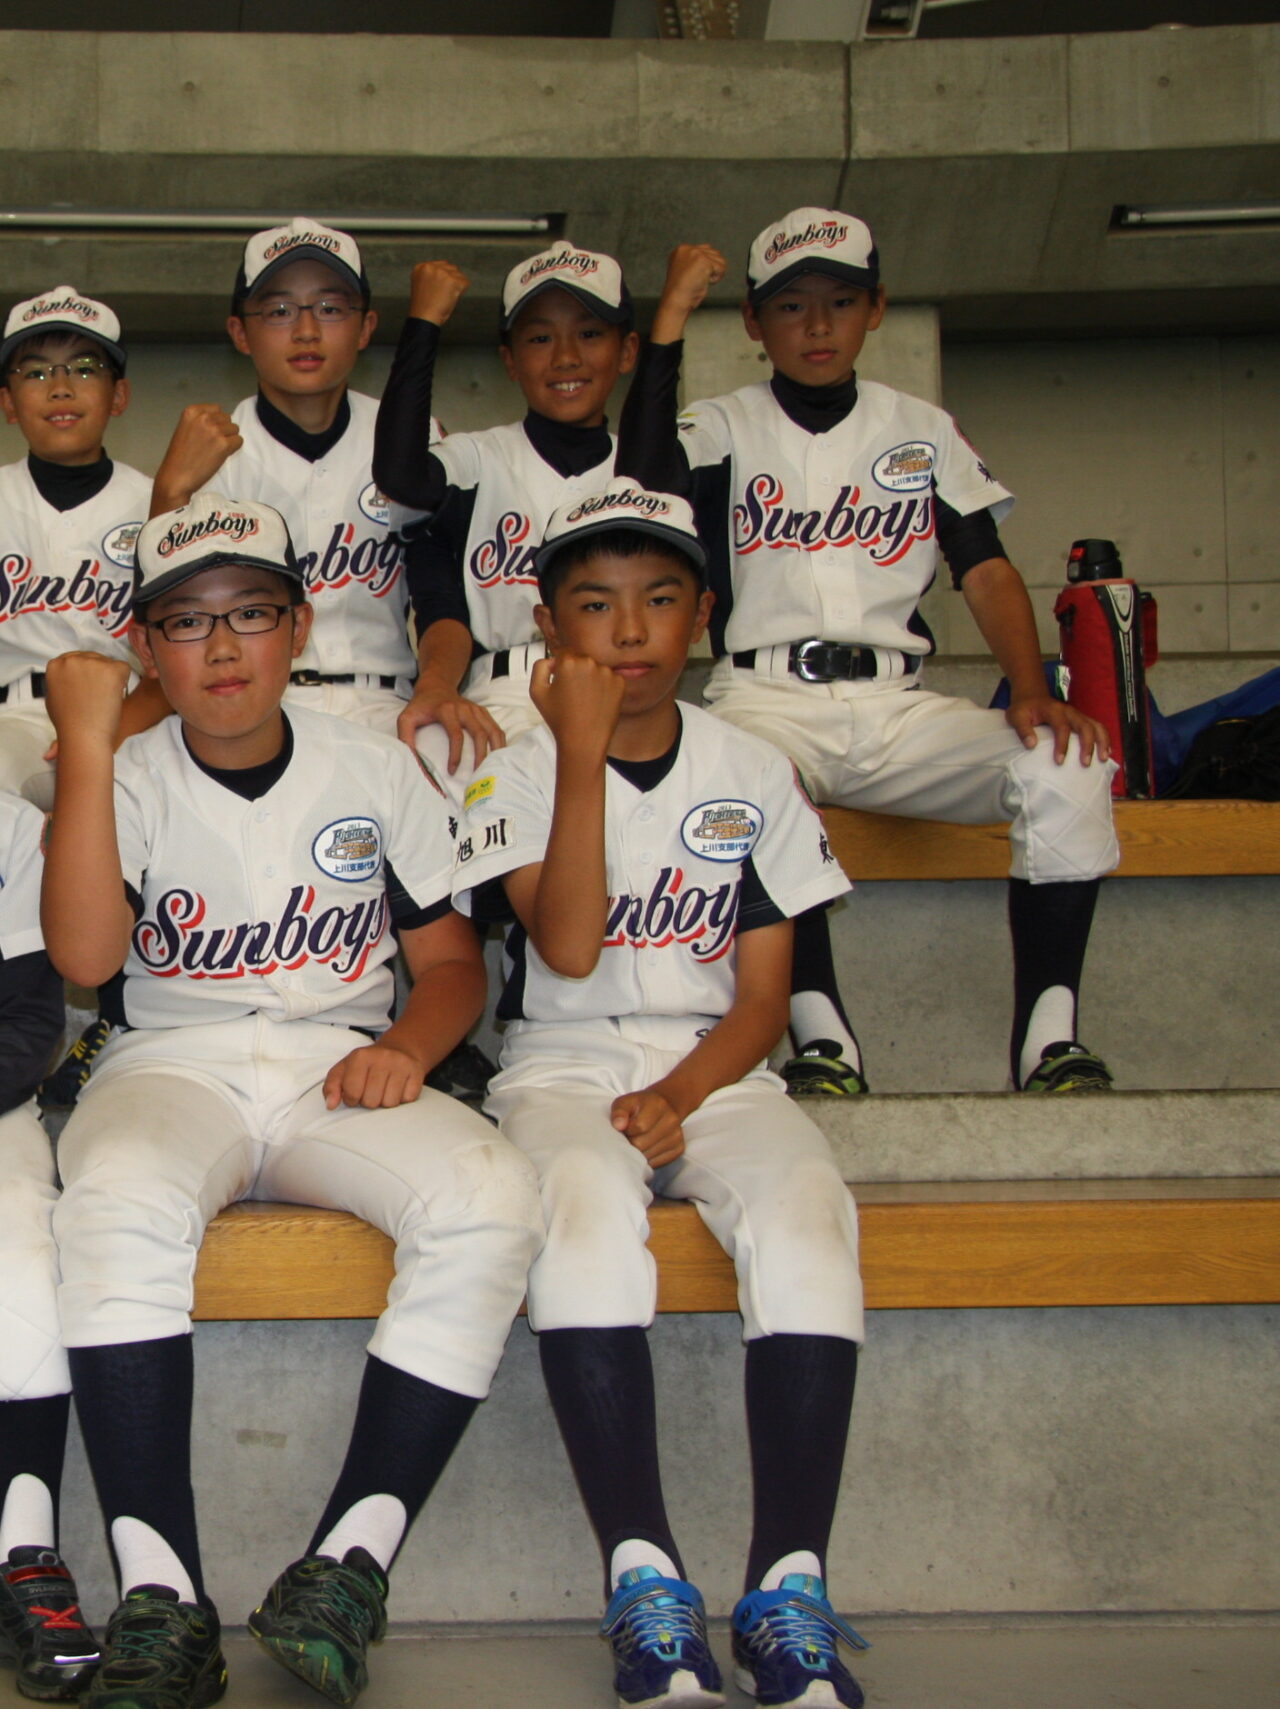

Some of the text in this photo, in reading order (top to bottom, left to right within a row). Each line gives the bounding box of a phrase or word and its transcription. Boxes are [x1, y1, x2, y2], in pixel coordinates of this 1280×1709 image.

[263, 231, 341, 260] Sunboys
[764, 221, 849, 264] Sunboys
[520, 250, 600, 285] Sunboys
[22, 296, 100, 323] Sunboys
[566, 487, 672, 524] Sunboys
[733, 473, 936, 567] Sunboys
[157, 511, 260, 560] Sunboys
[132, 884, 389, 983] Sunboys
